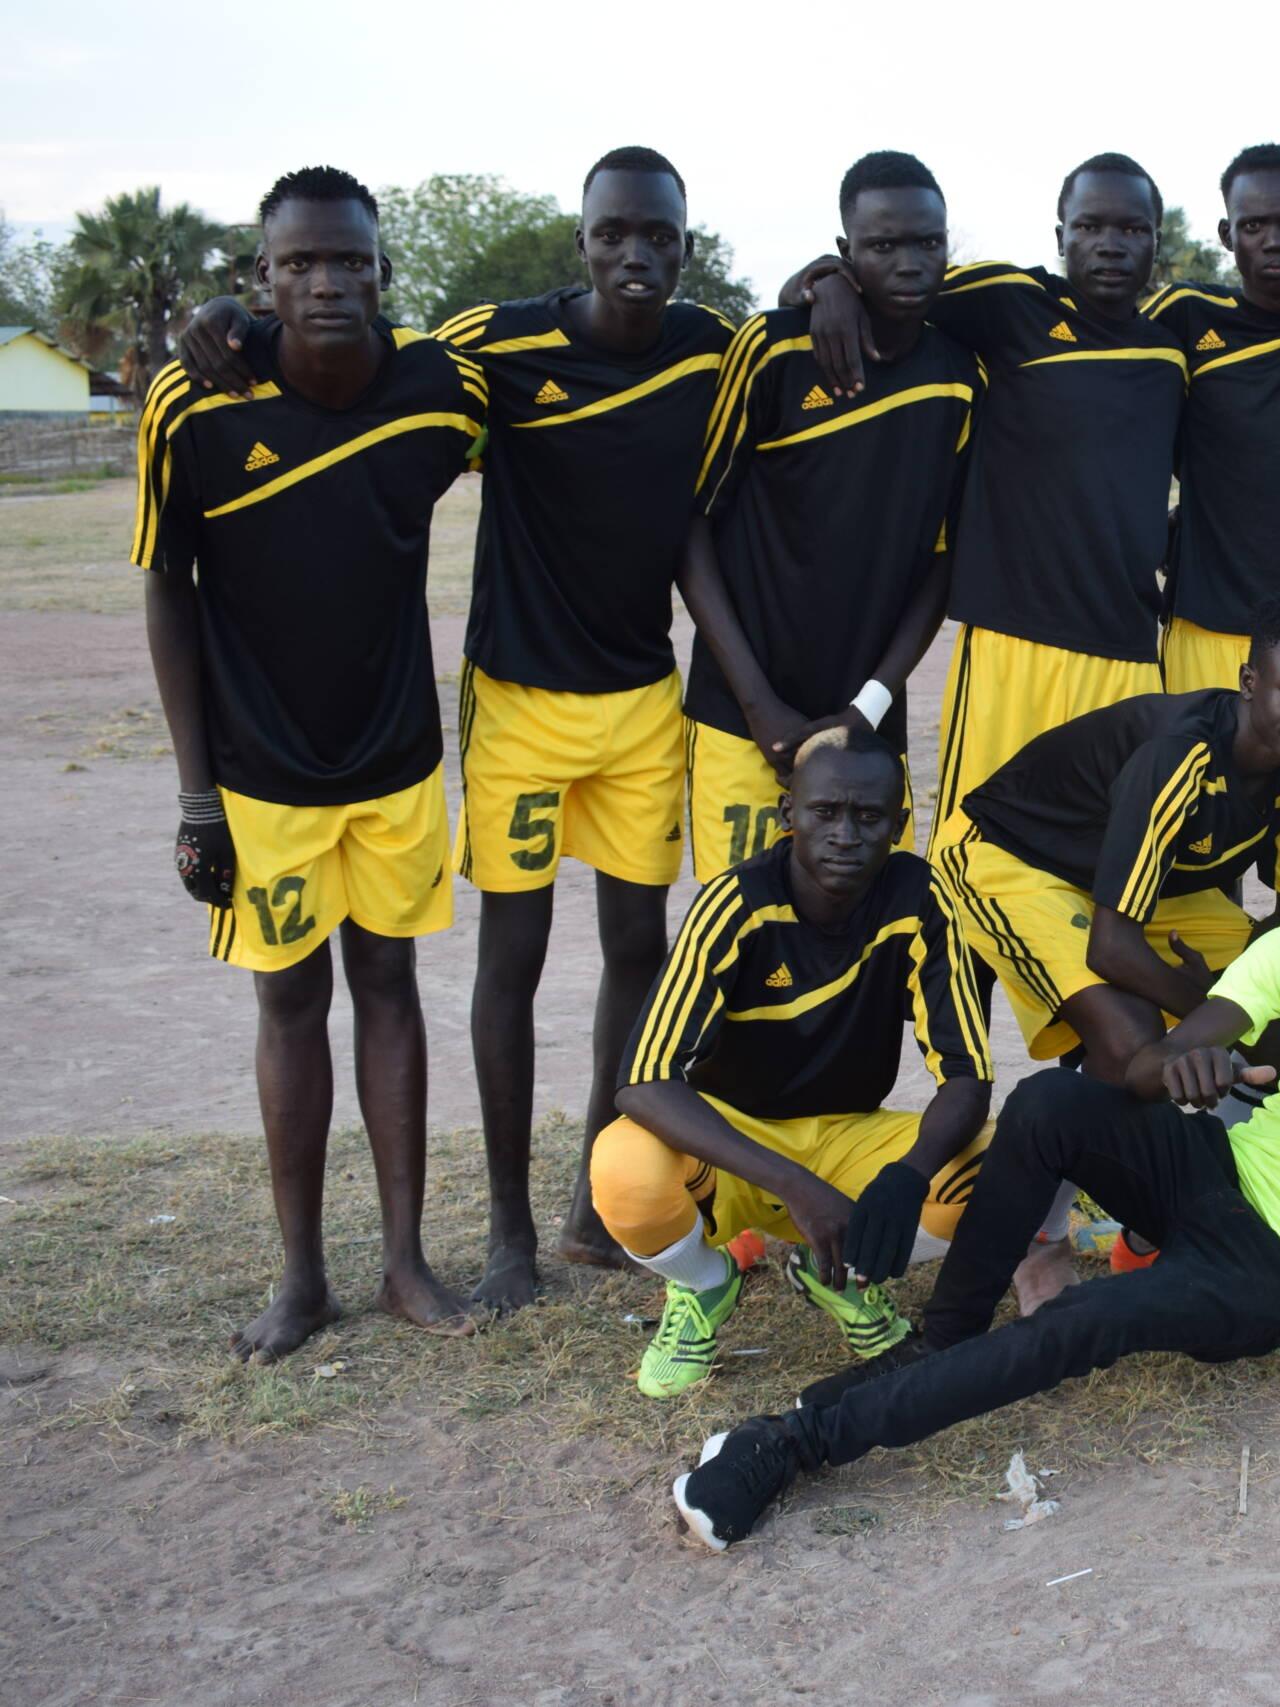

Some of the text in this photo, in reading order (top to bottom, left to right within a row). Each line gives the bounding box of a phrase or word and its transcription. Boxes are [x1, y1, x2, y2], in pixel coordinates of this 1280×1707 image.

[1195, 341, 1226, 350] adidas
[535, 392, 568, 404] adidas
[802, 397, 833, 410] adidas
[245, 454, 280, 471] adidas
[507, 791, 560, 872] 5
[247, 875, 316, 946] 12
